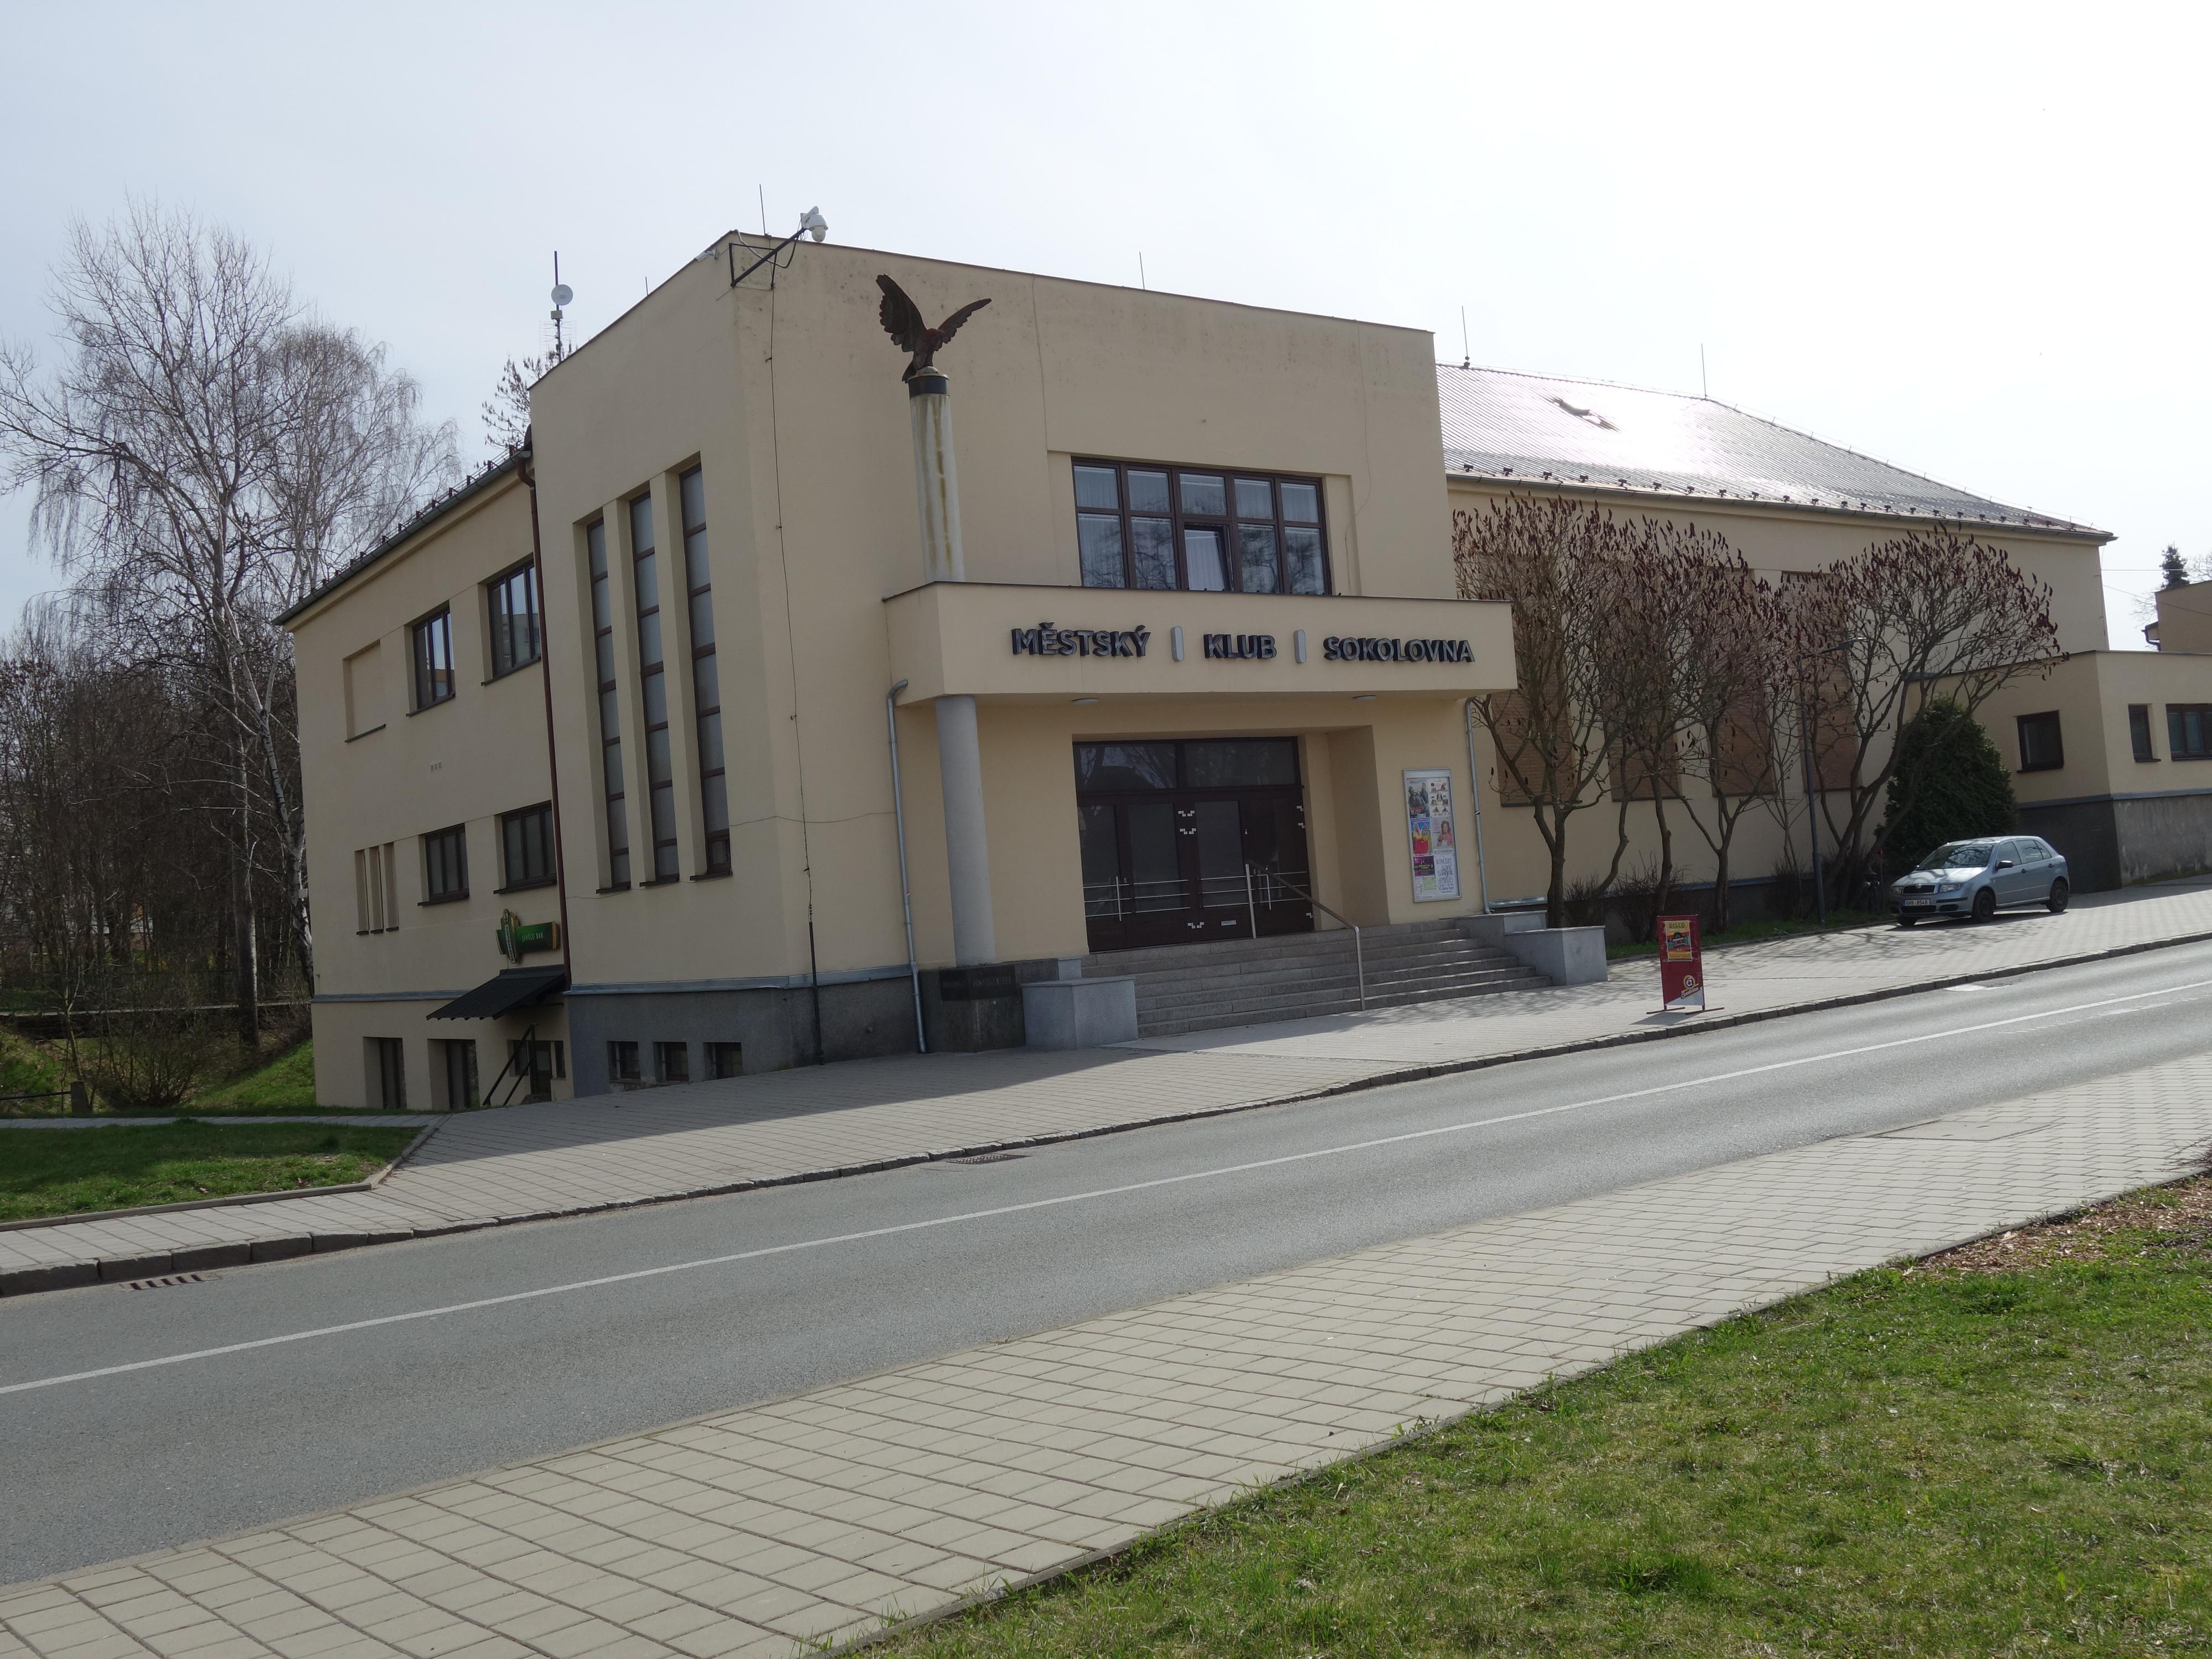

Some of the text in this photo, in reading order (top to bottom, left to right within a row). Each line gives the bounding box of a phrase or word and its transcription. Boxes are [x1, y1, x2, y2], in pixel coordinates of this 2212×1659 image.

[1011, 622, 1476, 663] MĚSTSKÝ KLUB SOKOLOVNA
